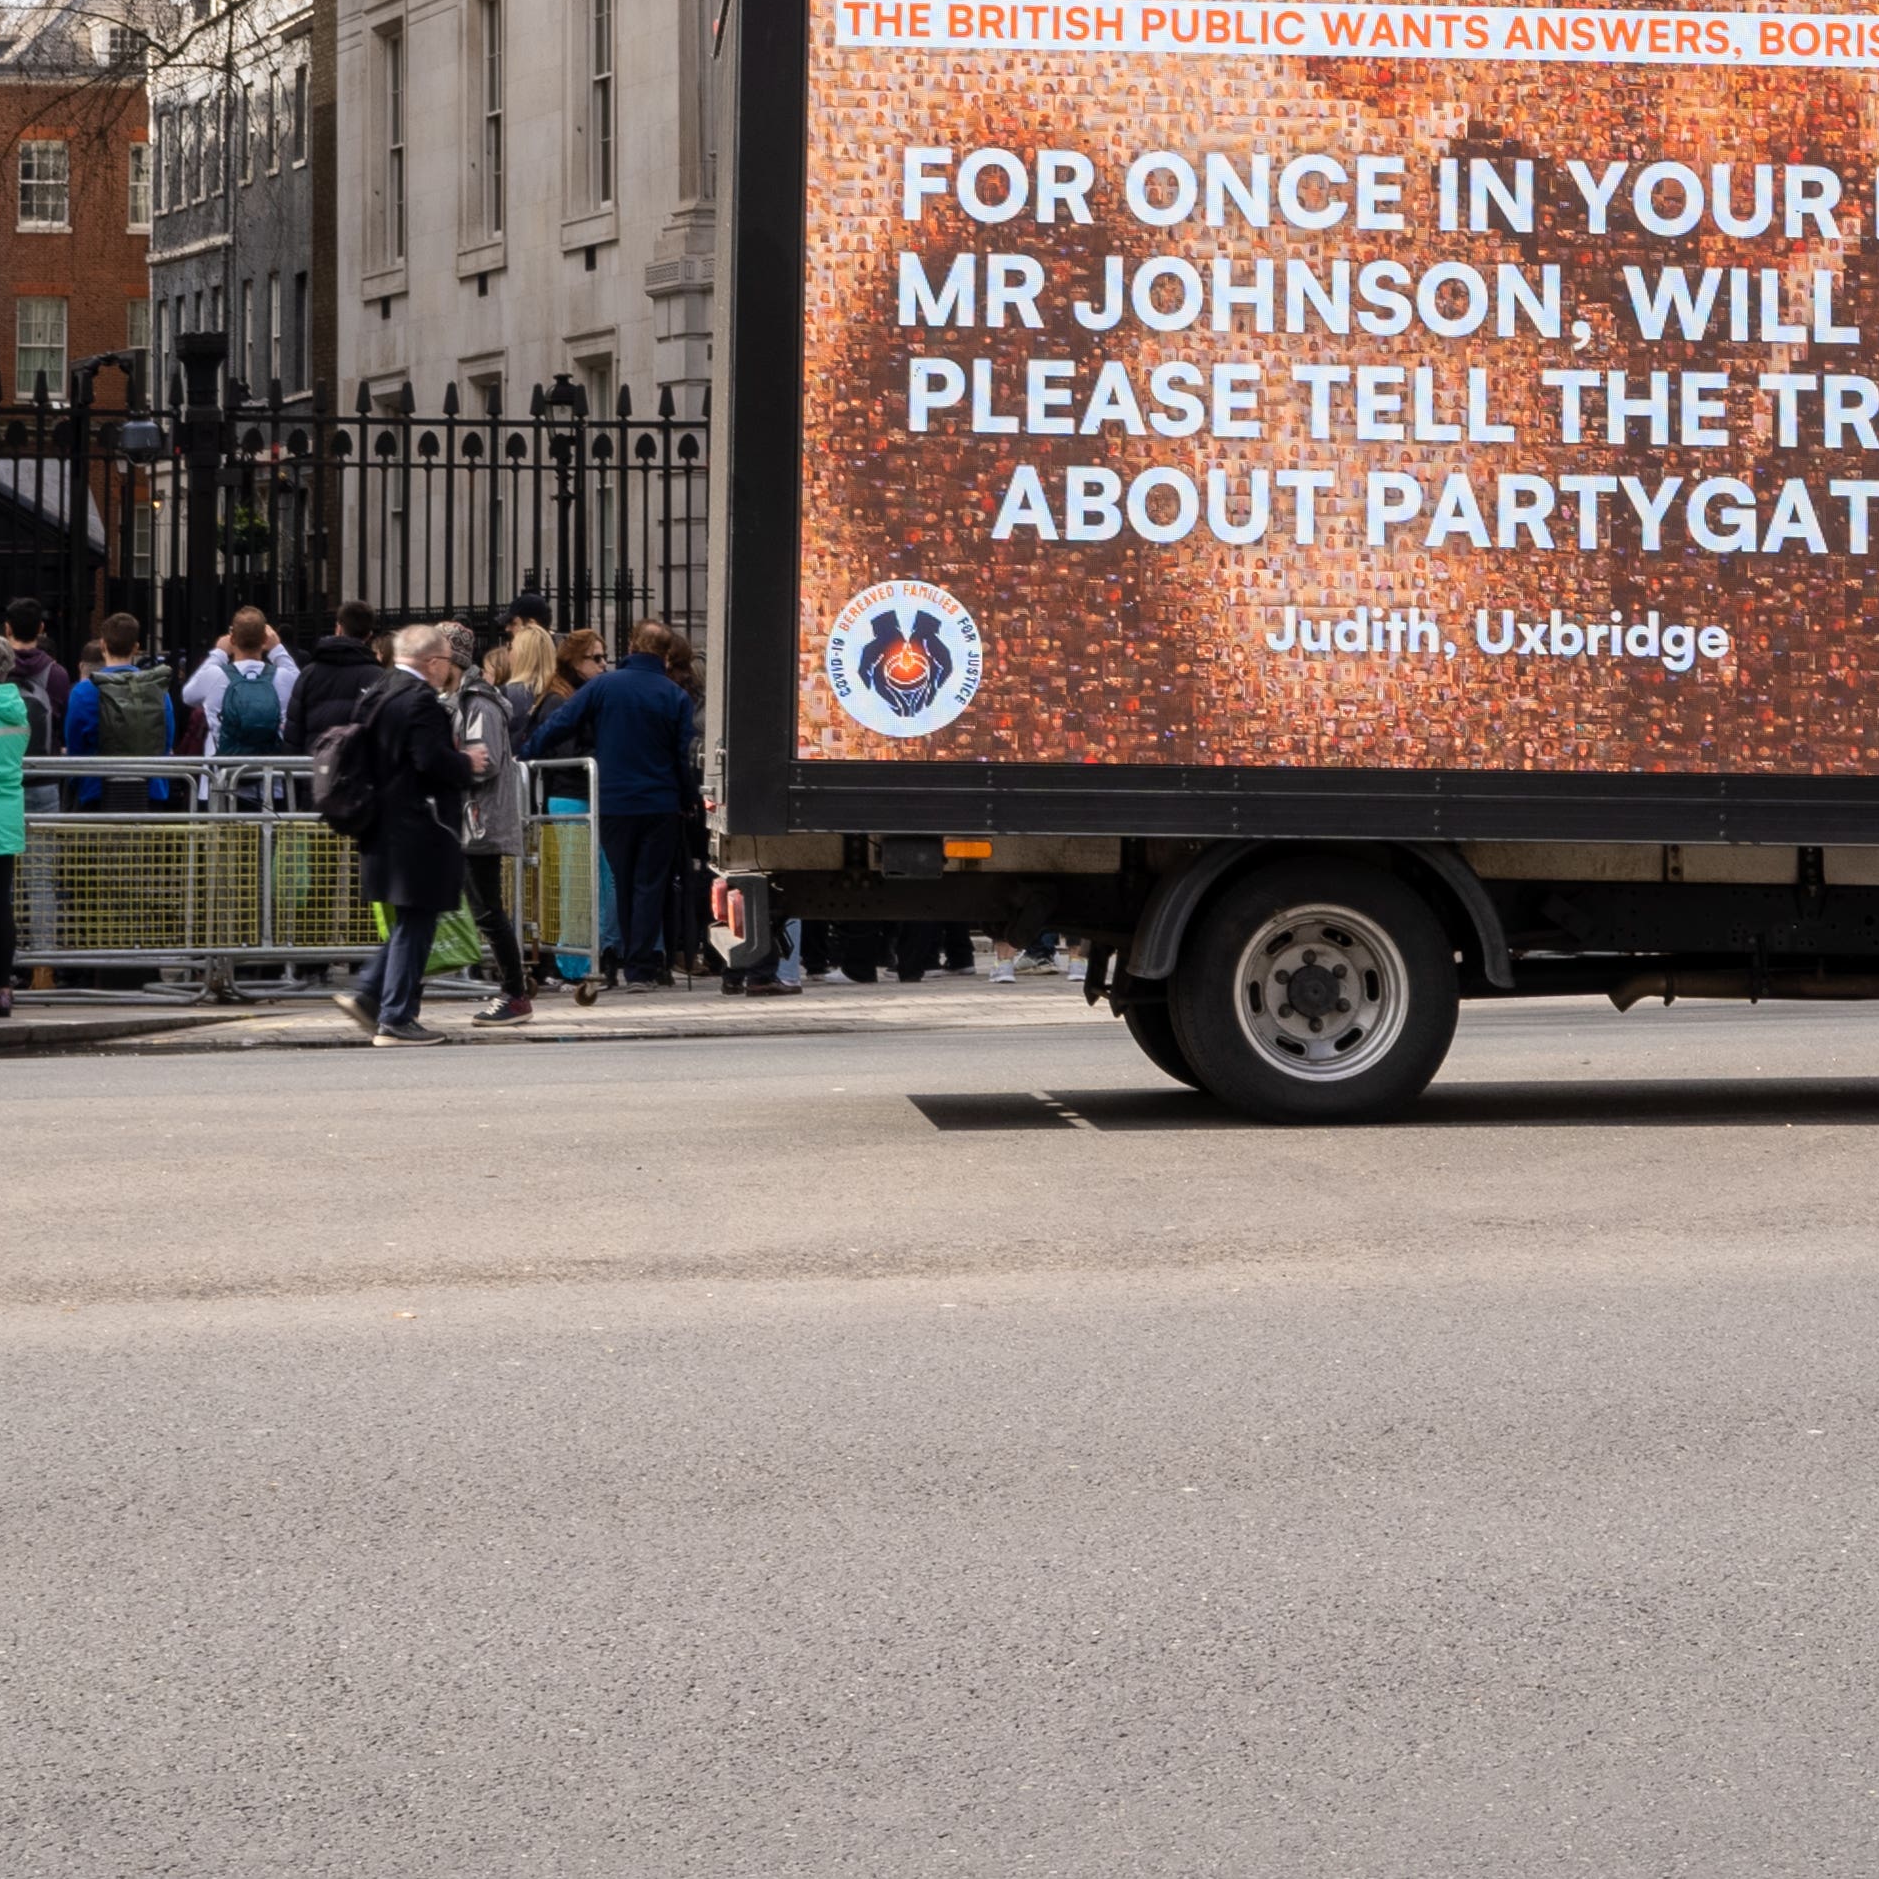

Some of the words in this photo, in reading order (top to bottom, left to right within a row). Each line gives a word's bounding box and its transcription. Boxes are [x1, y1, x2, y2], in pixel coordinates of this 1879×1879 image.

[843, 1, 932, 38] THE
[947, 4, 1123, 43] BRITISH
[1141, 8, 1306, 46] PUBLIC
[1320, 11, 1490, 50] WANTS
[1503, 14, 1743, 60] ANSWERS,
[902, 147, 1096, 225] FOR
[1125, 150, 1406, 231] ONCE
[1439, 157, 1534, 234] IN
[1566, 160, 1844, 240] YOUR
[897, 252, 1045, 329] MR
[1072, 254, 1592, 351] JOHNSON,
[1623, 265, 1861, 345] WILL
[907, 357, 1262, 438] PLEASE
[1291, 364, 1516, 443] TELL
[1542, 370, 1730, 447] THE
[990, 464, 1335, 546] ABOUT
[837, 584, 895, 633] BEREAVED
[902, 583, 960, 616] FAMILIES
[957, 615, 977, 643] FOR
[830, 637, 852, 698] COVID-19
[1266, 605, 1456, 661] Judith,
[1475, 609, 1730, 672] Uxbridge
[953, 651, 981, 706] JUSTICE
